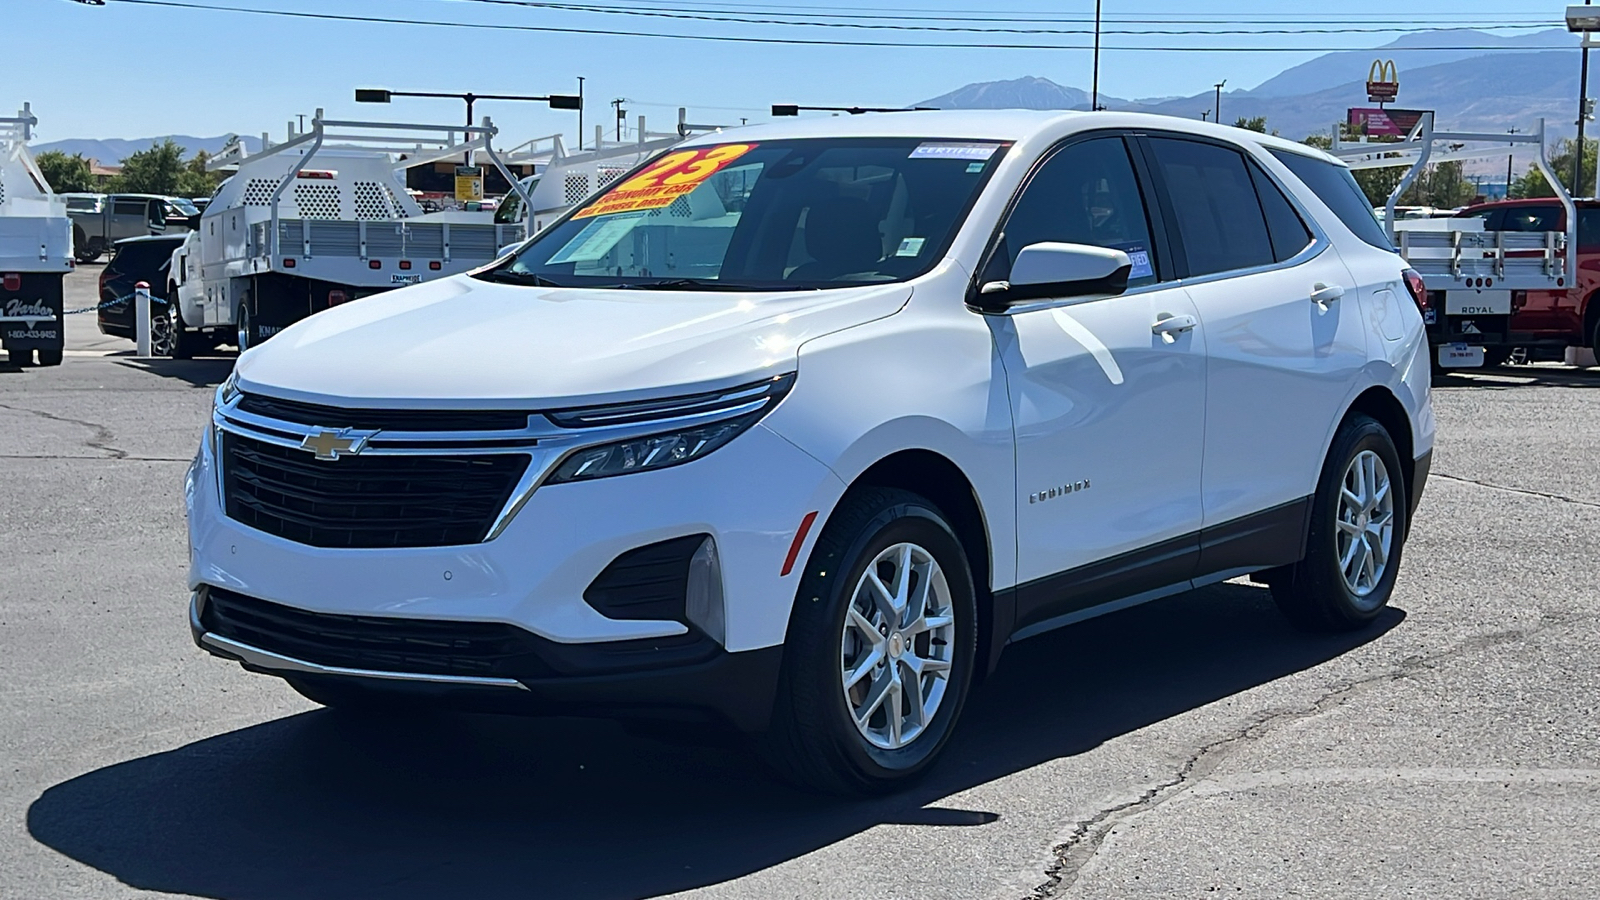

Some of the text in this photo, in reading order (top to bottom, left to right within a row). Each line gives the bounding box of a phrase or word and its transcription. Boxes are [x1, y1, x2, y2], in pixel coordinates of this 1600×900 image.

[917, 147, 991, 155] CERTIFIED
[614, 143, 751, 193] 23
[597, 183, 699, 205] ECONOMY CAR
[576, 206, 600, 217] ALL
[597, 200, 638, 213] WHEEL
[635, 196, 676, 207] DRIVE
[6, 298, 54, 318] Harbor
[1461, 306, 1494, 314] ROYAL
[1029, 478, 1091, 505] EQUINOX
